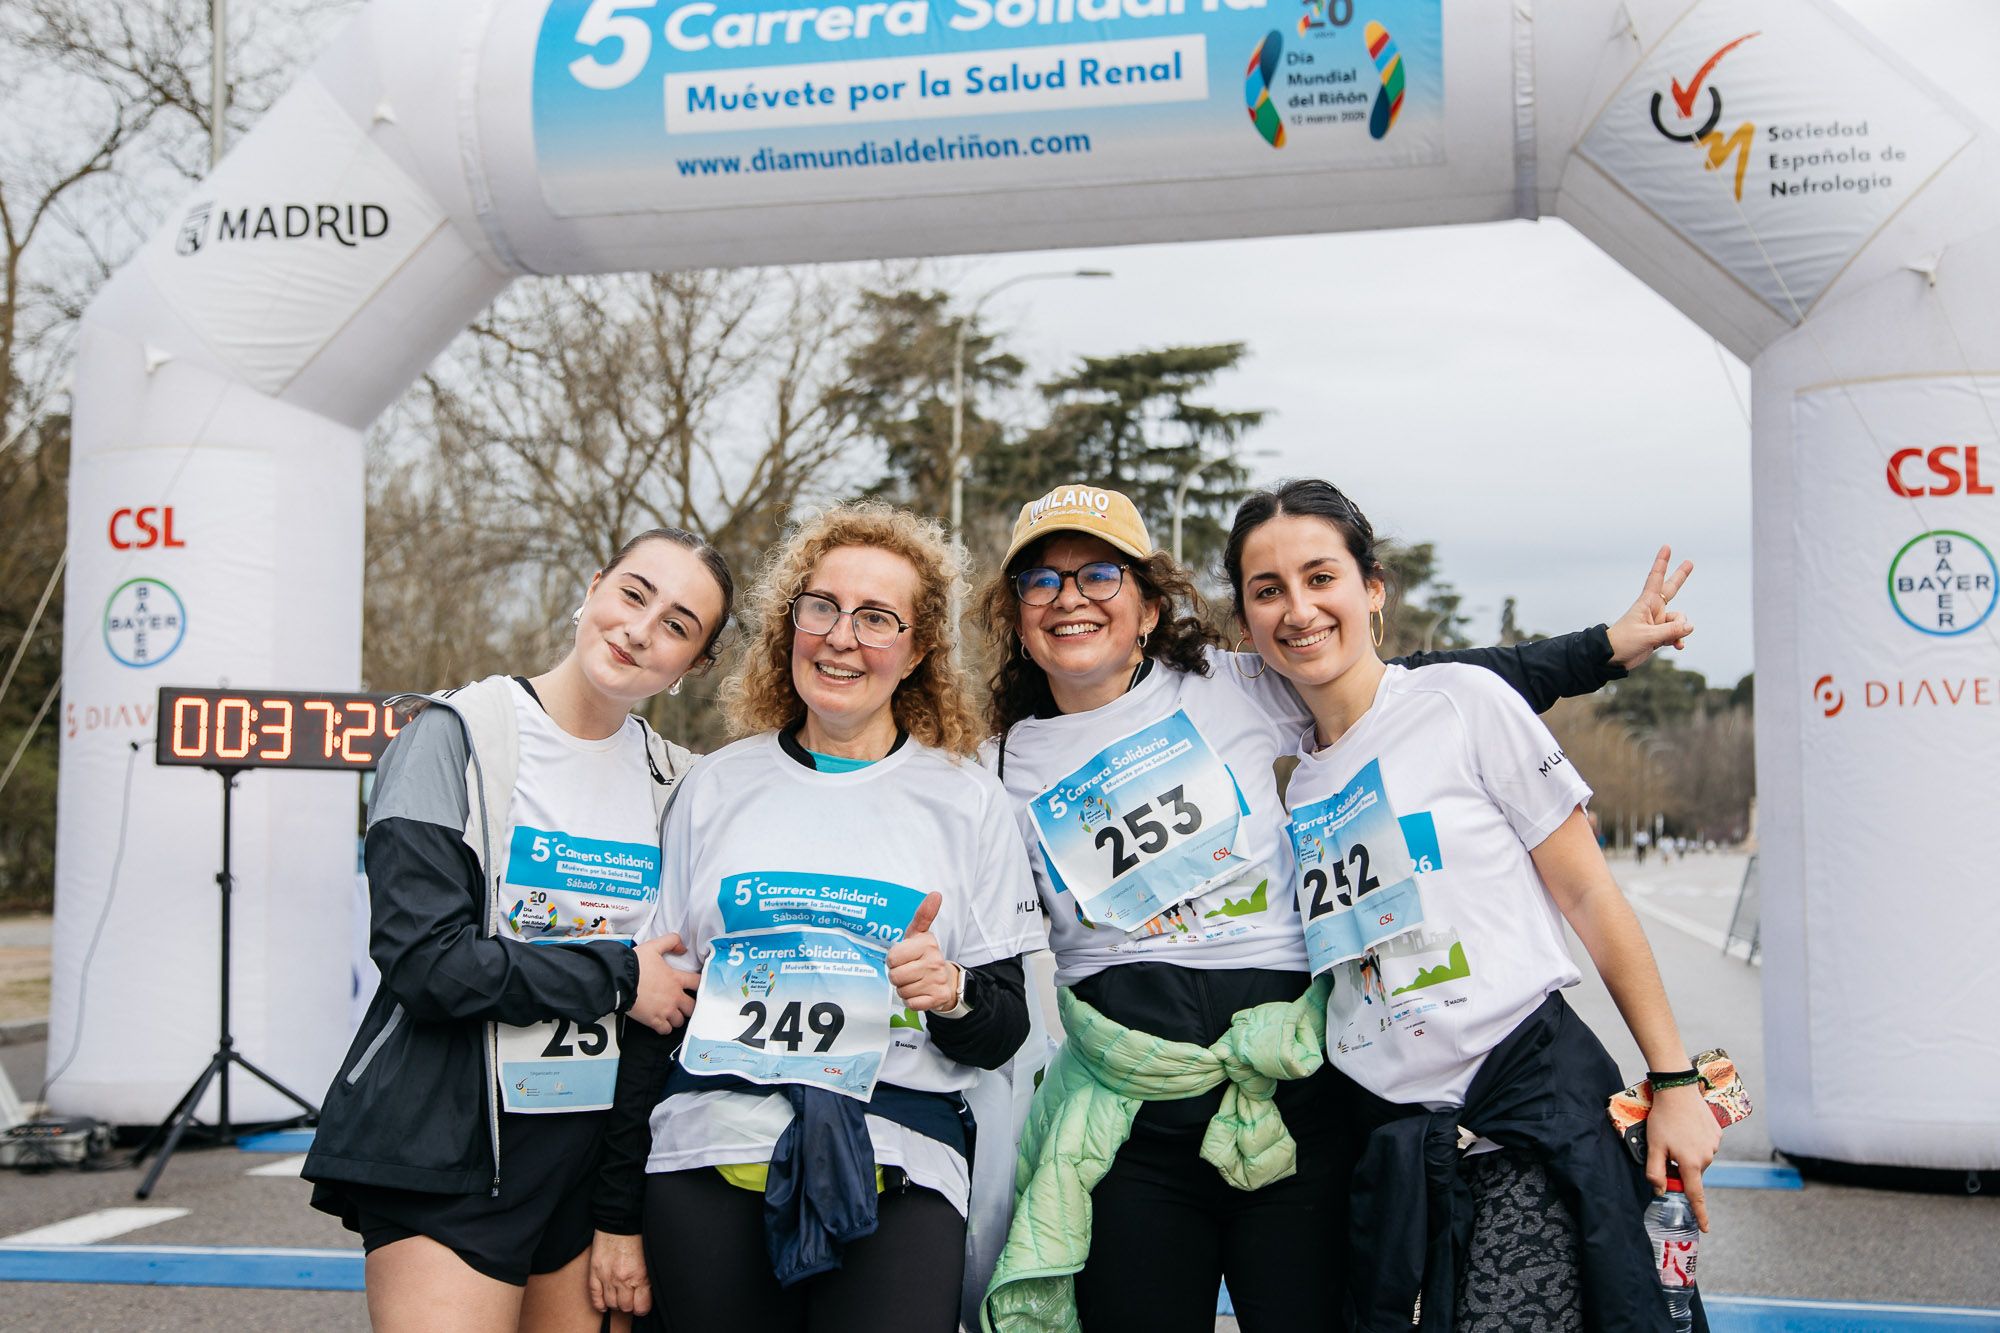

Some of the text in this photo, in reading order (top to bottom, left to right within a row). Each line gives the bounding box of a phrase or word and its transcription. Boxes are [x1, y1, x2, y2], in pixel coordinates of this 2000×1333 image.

[664, 0, 929, 52] Carrera
[687, 51, 1183, 113] Muévete por la Salud Renal
[1287, 68, 1357, 87] Mundial
[1288, 91, 1369, 109] del Riñón
[1768, 121, 1869, 143] Sociedad
[677, 132, 1091, 177] www.diamundialdelriñon.com
[1769, 146, 1907, 173] Española de
[218, 202, 390, 247] MADRID
[1886, 445, 1995, 498] CSL
[1030, 490, 1110, 520] MILANO
[108, 506, 187, 550] CSL
[1898, 574, 1991, 593] BAYER
[1934, 539, 1954, 629] BAYER
[1864, 677, 2000, 708] DIAVE
[1066, 767, 1112, 801] Carrera
[1111, 737, 1170, 770] Solidaria
[1094, 783, 1203, 880] 253
[555, 843, 602, 863] Carrera
[603, 851, 654, 871] Solidaria
[1213, 846, 1232, 861] CSL
[566, 877, 598, 890] Sábado
[599, 882, 605, 890] 7
[606, 883, 615, 892] de
[616, 886, 641, 897] marzo
[756, 882, 816, 897] Carrera
[819, 886, 888, 907] Solidaria
[1303, 843, 1380, 922] 252
[772, 911, 810, 923] Sábado
[817, 915, 831, 925] de
[832, 917, 863, 932] marzo
[1379, 912, 1394, 926] CSL
[748, 946, 796, 960] Carrera
[798, 944, 861, 961] Solidaria
[732, 1001, 845, 1053] 249
[823, 1067, 843, 1075] CSL
